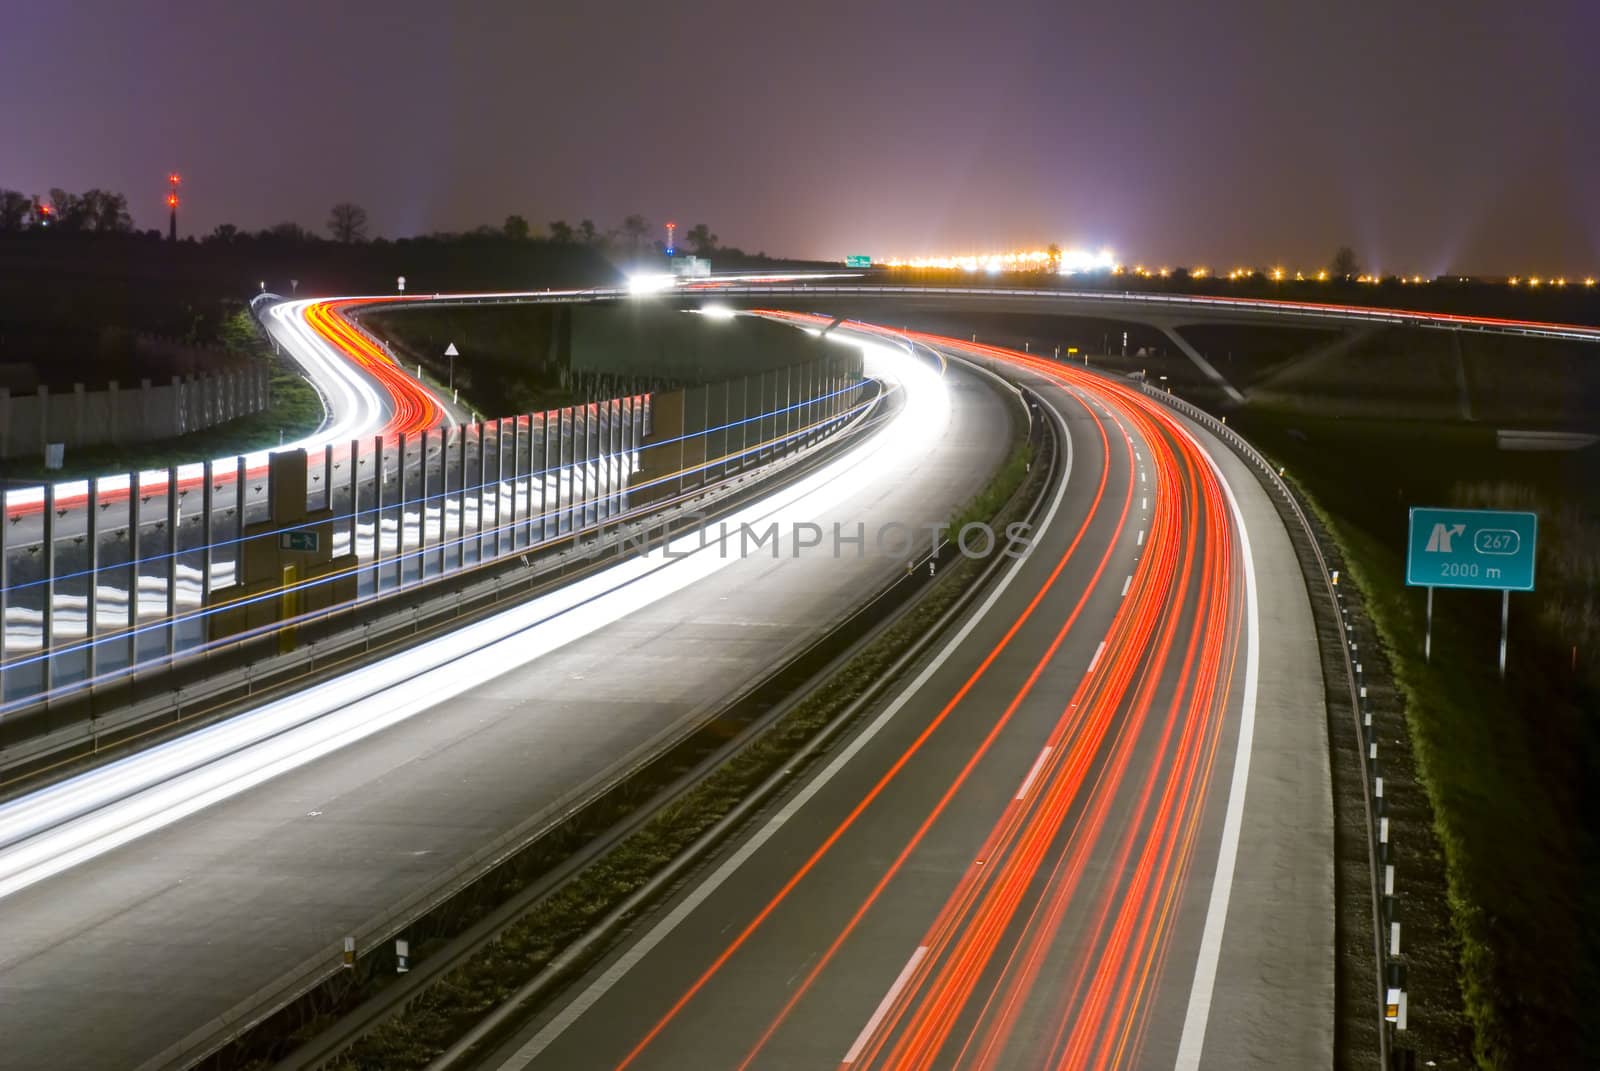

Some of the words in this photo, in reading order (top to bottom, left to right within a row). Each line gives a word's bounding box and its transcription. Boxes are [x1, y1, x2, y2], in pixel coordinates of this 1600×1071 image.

[1483, 535, 1511, 549] 267
[1441, 562, 1479, 577] 2000
[1485, 567, 1501, 579] m
